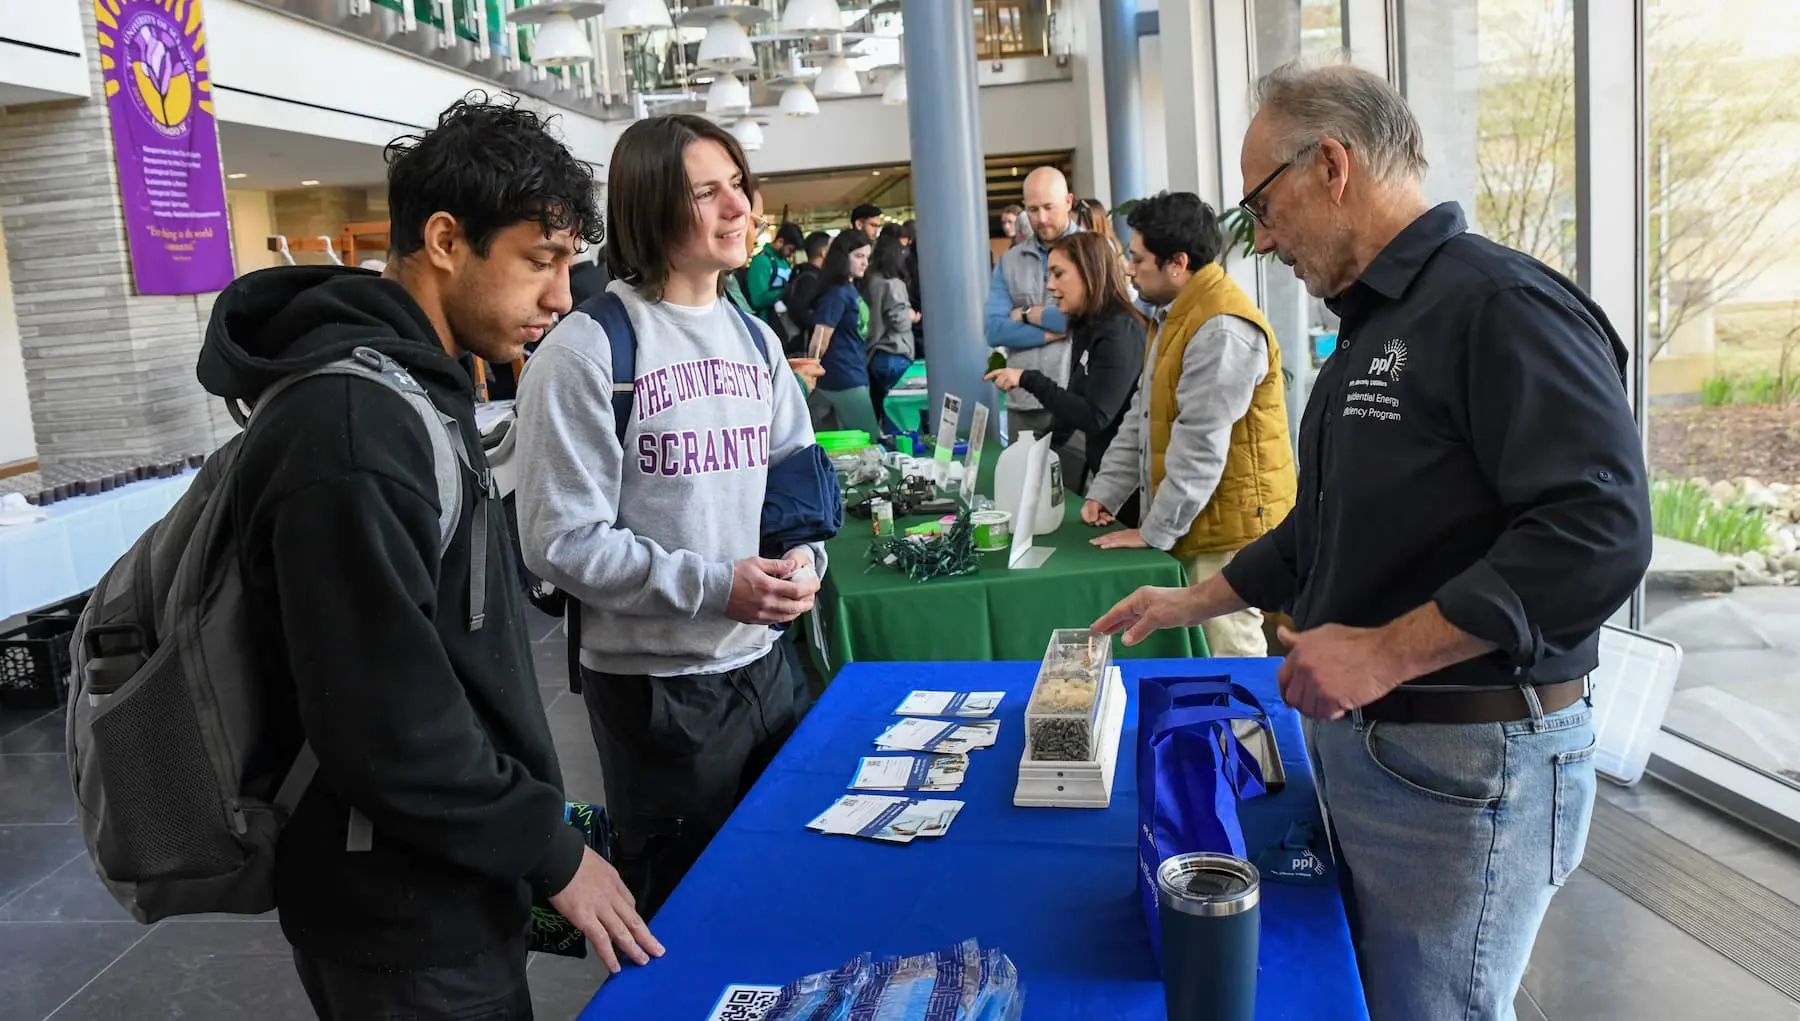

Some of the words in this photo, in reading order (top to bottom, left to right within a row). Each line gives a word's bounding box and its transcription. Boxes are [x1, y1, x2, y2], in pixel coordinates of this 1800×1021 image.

[1368, 352, 1394, 375] ppl
[634, 368, 673, 421] THE
[1346, 392, 1375, 402] idential
[1376, 393, 1399, 407] Energy
[1343, 406, 1368, 418] iency
[1368, 407, 1401, 420] Program
[638, 425, 768, 477] SCRANTO
[1292, 856, 1313, 870] ppl
